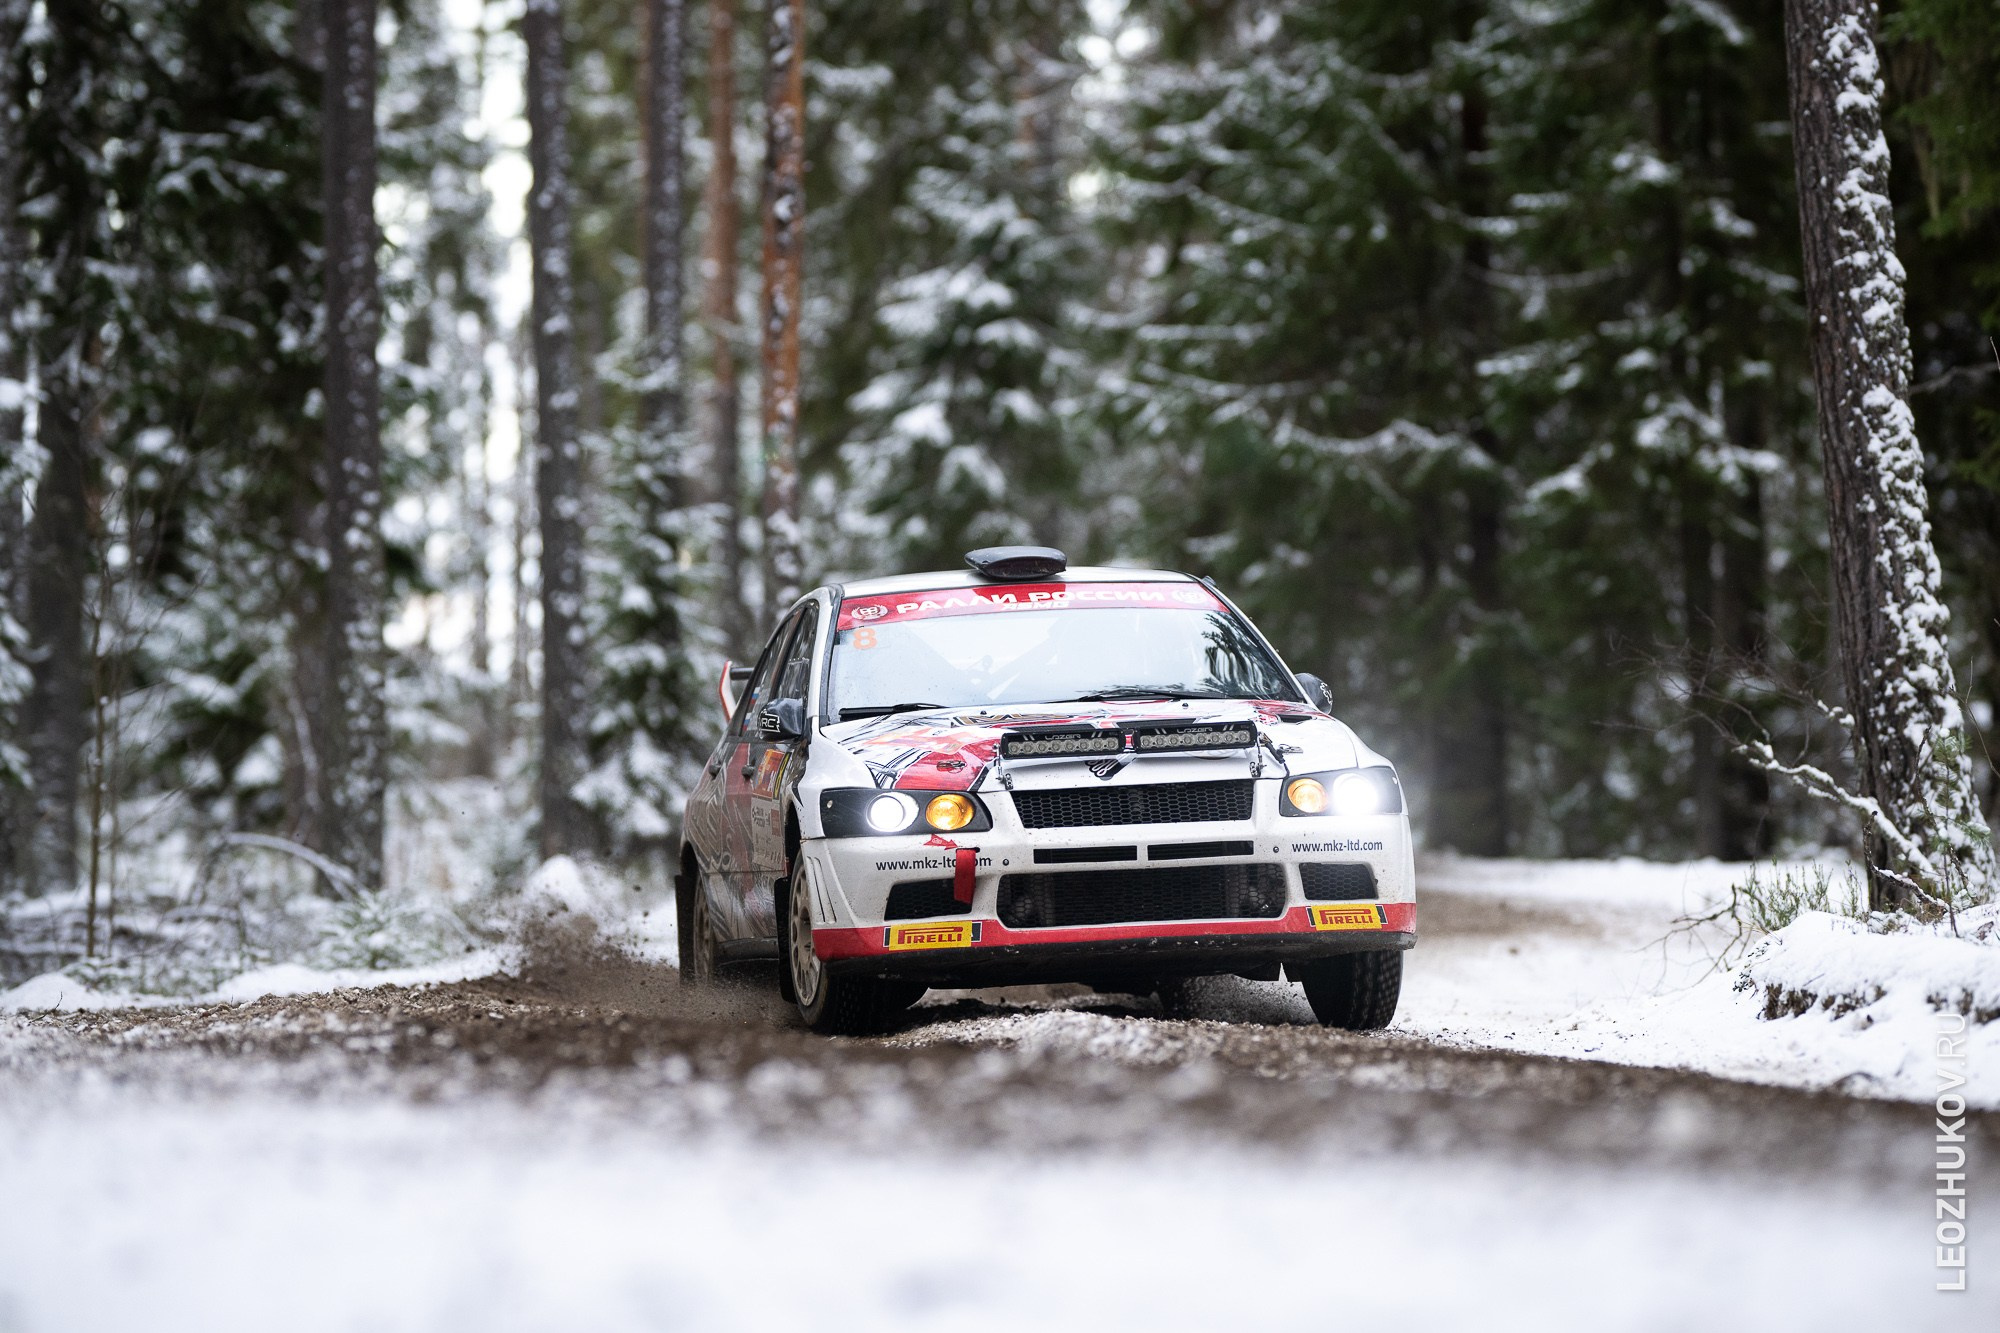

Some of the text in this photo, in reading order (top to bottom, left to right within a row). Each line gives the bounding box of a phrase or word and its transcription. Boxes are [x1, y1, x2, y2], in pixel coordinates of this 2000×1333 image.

[896, 593, 1018, 615] РАЛЛИ
[1028, 590, 1165, 603] РОССИИ
[853, 627, 878, 650] 8
[1044, 733, 1081, 741] LAZER
[1292, 839, 1383, 852] www.mkz-ltd.com
[1318, 908, 1374, 925] PIRELLI
[897, 926, 964, 945] PIRELLI
